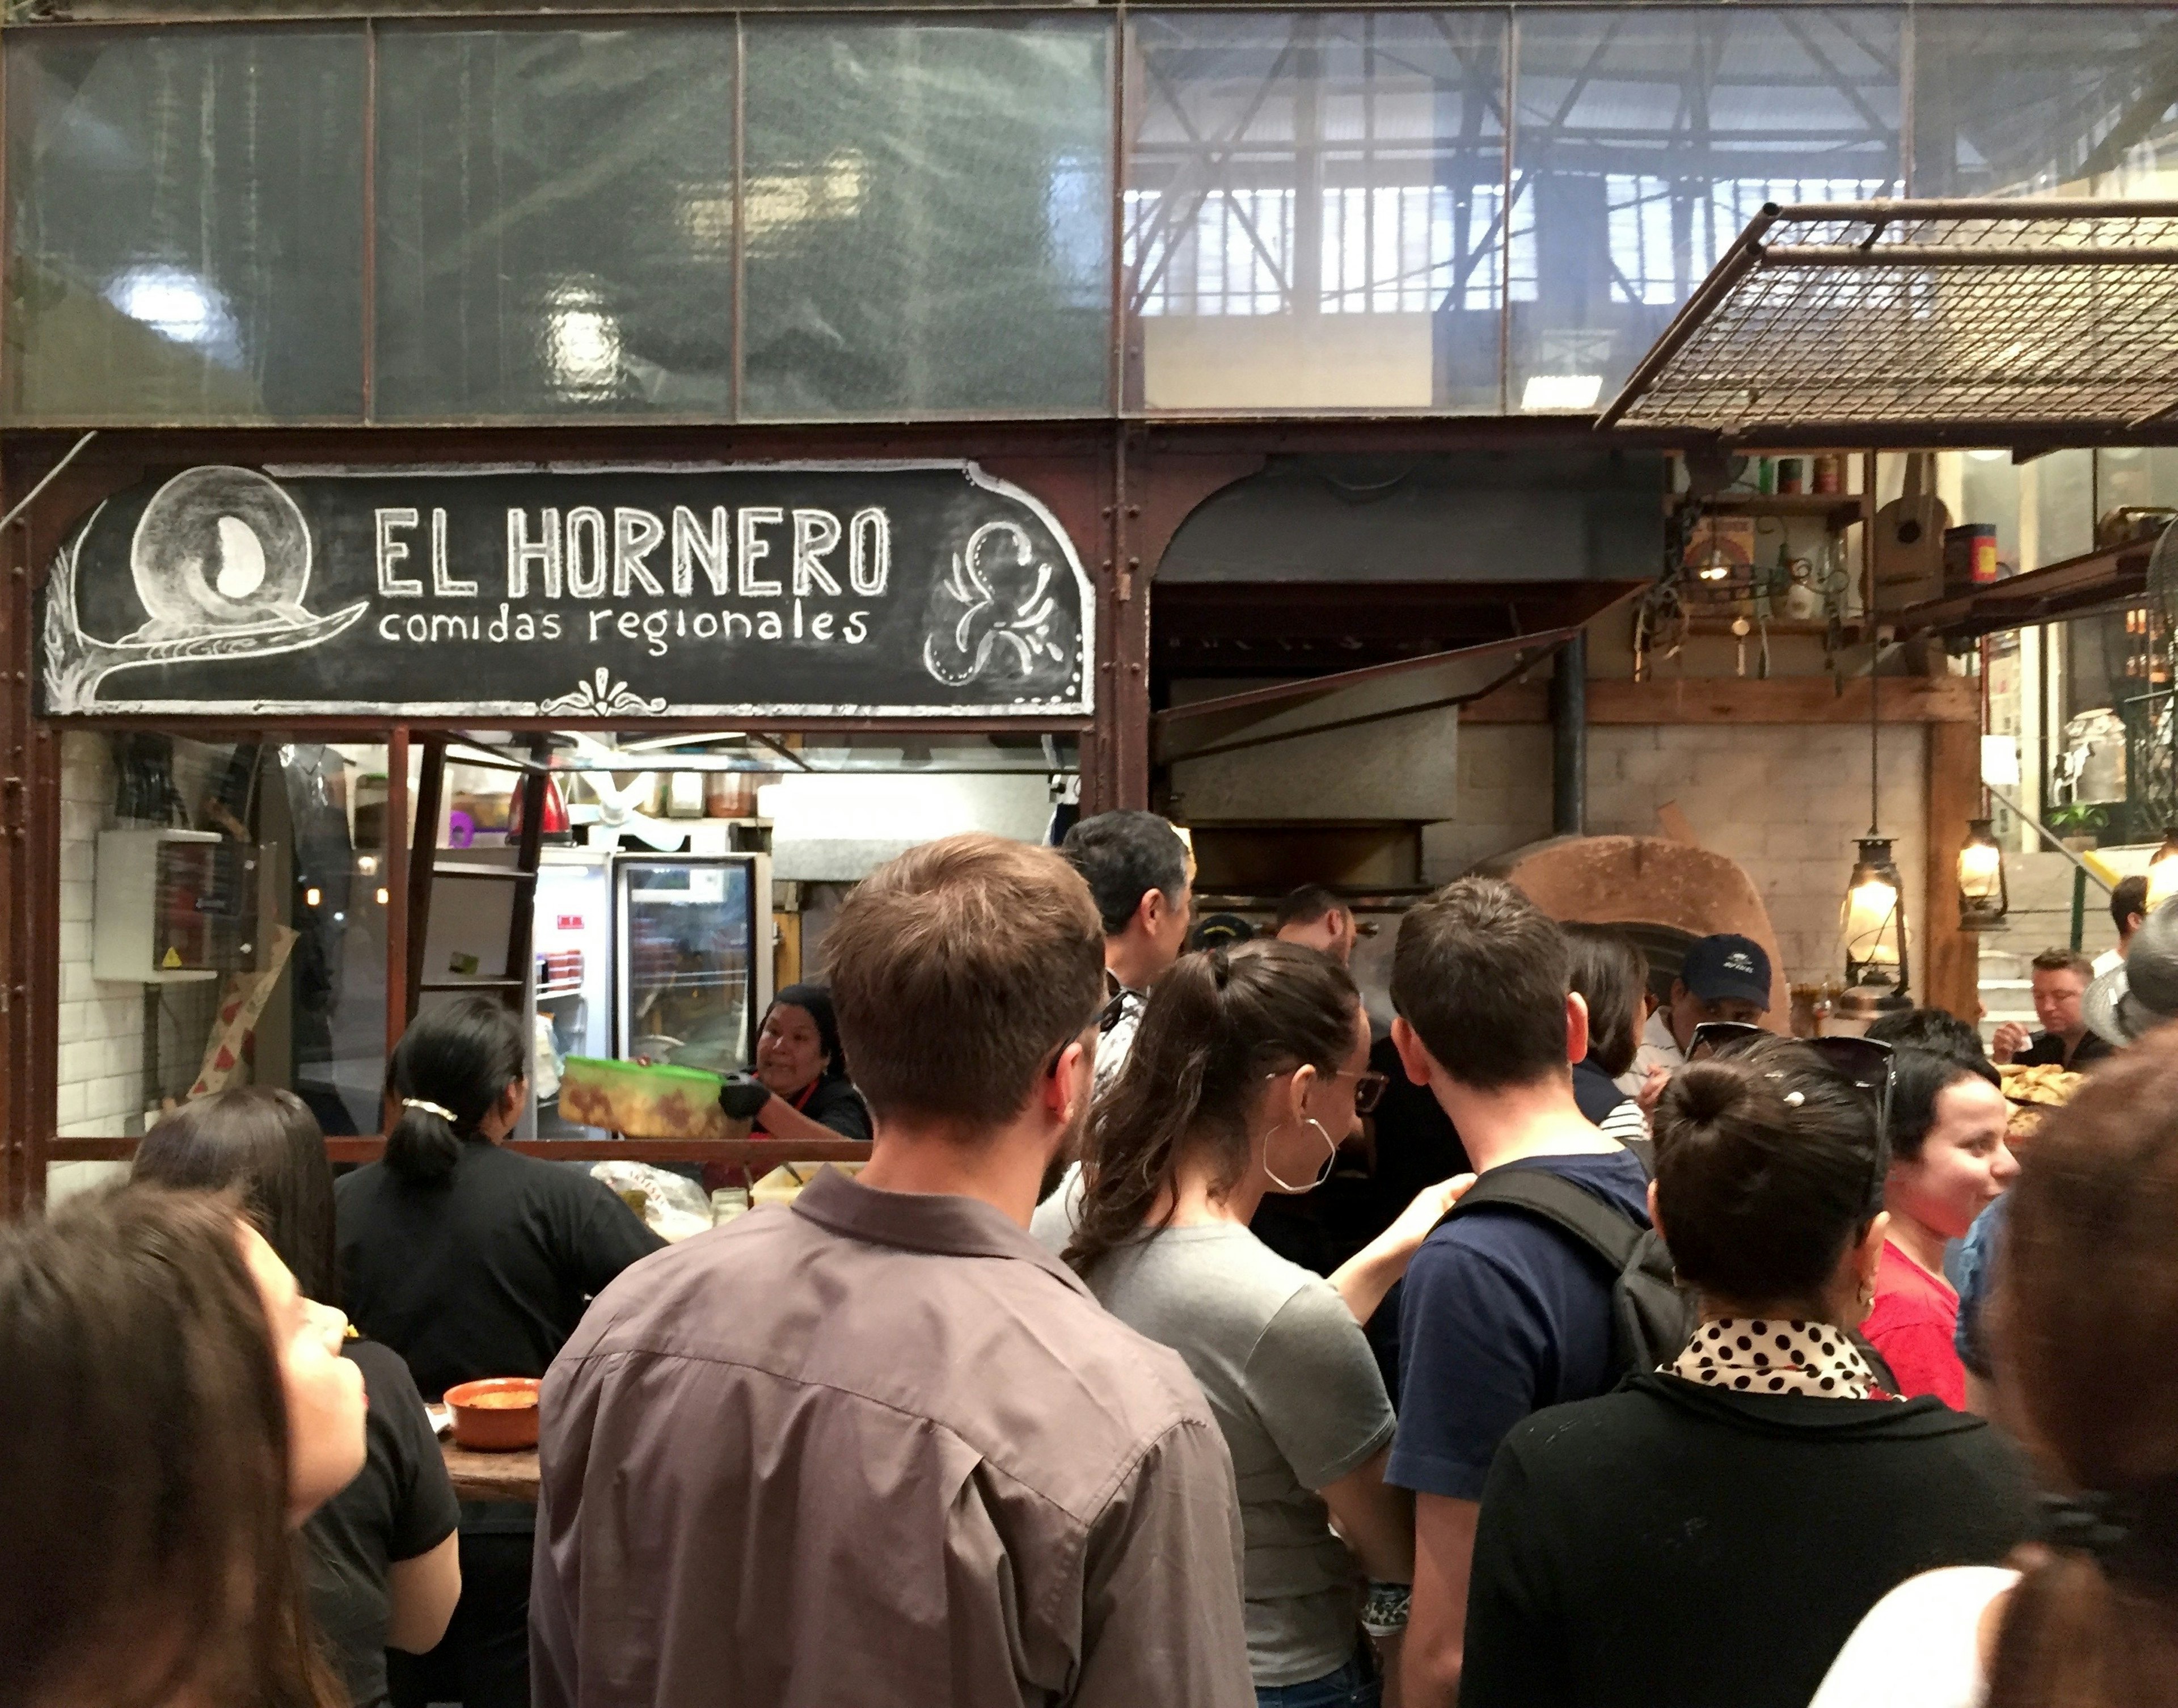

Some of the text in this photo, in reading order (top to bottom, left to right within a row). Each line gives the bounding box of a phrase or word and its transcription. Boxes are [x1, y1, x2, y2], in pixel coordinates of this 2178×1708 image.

[375, 505, 891, 598] EL HORNERO
[379, 598, 871, 657] comidas regionales
